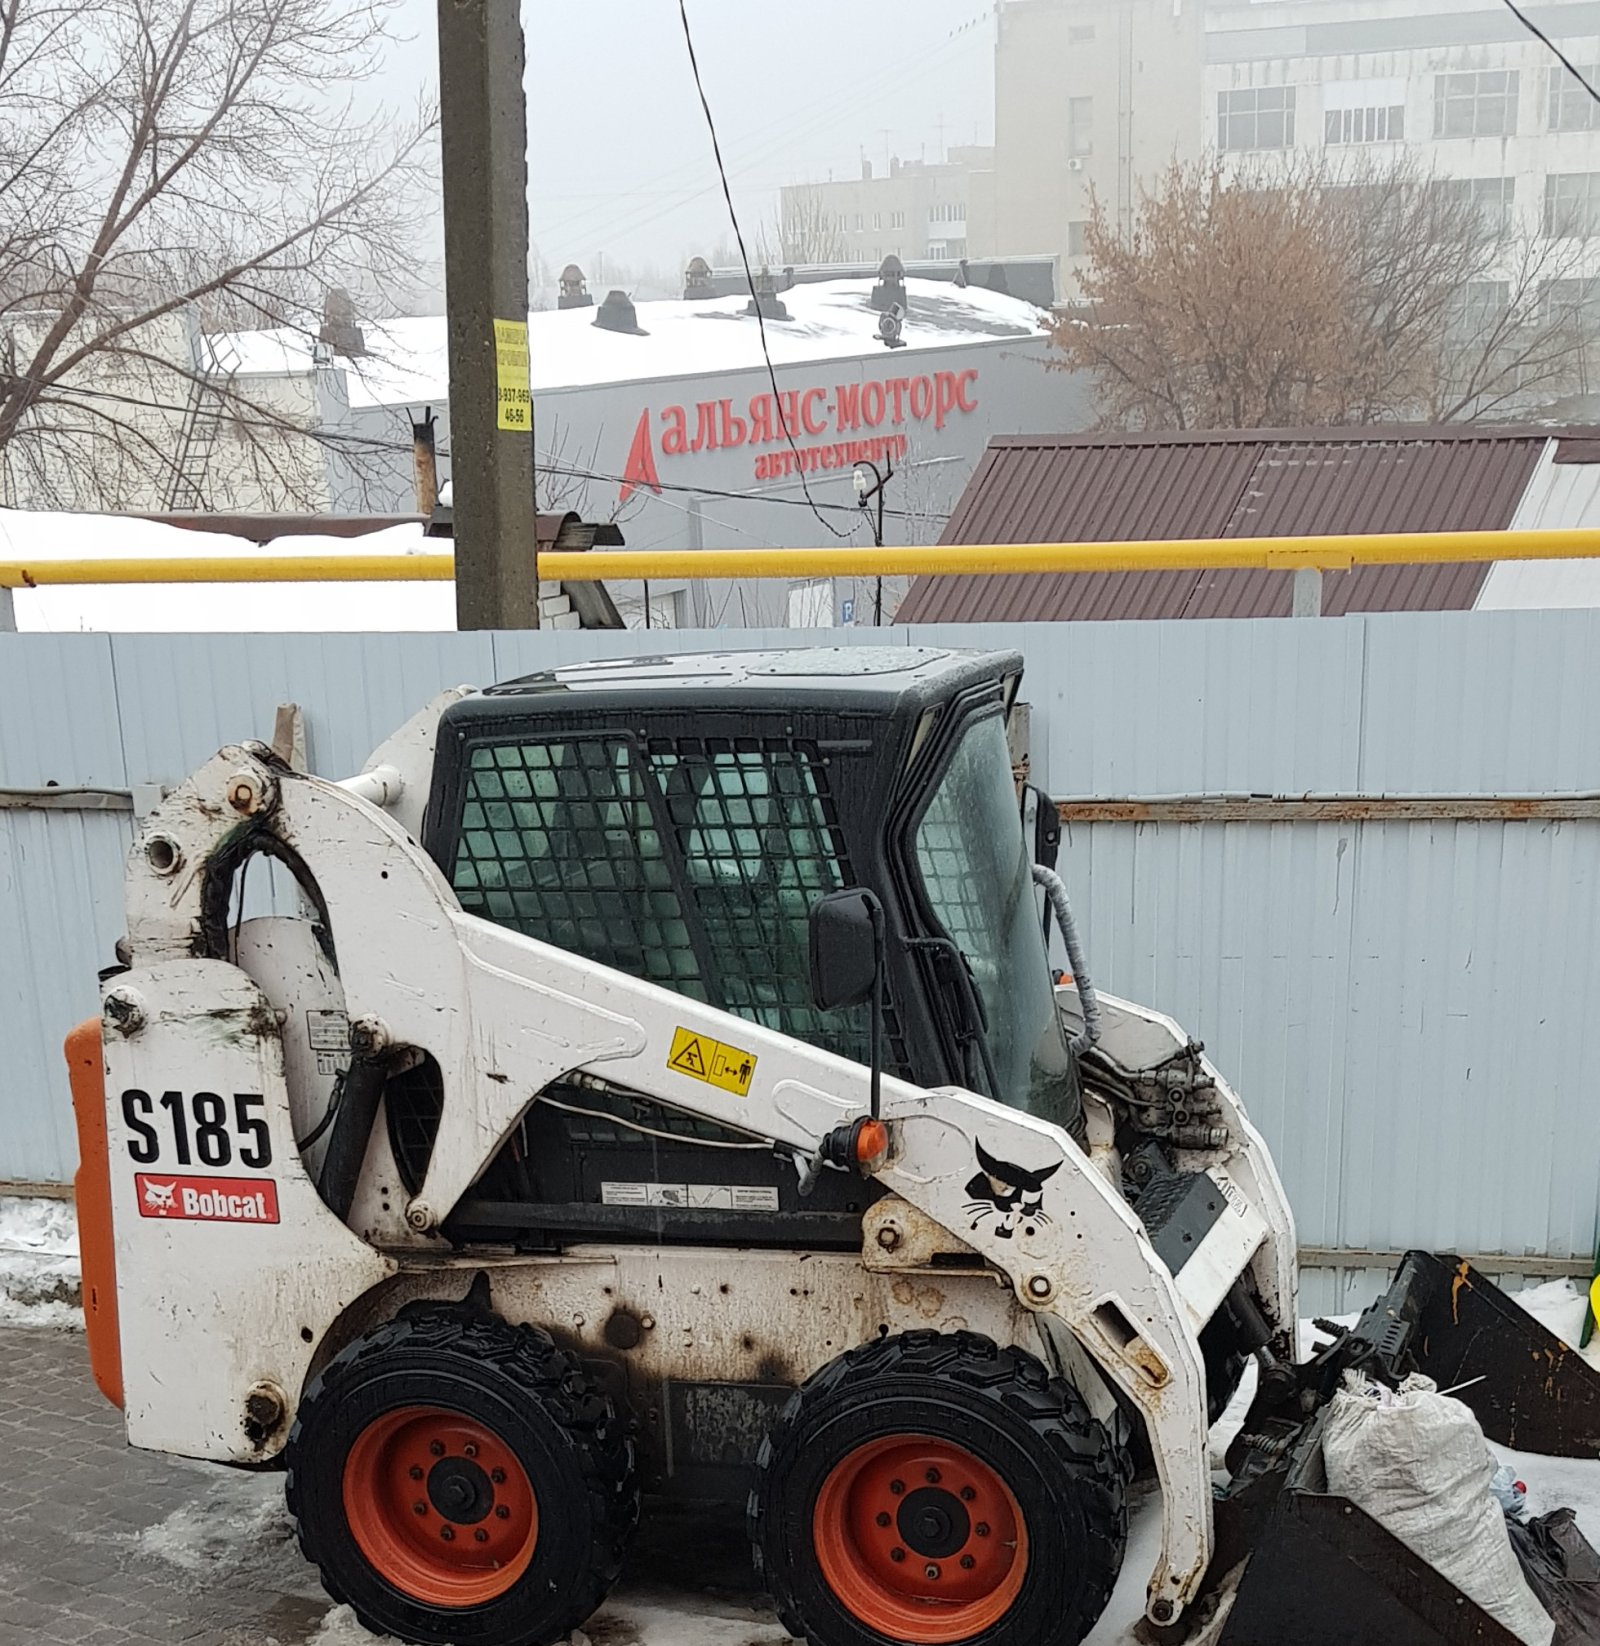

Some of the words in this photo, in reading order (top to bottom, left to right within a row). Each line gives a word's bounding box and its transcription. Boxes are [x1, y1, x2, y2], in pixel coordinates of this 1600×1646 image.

[754, 434, 908, 480] автотехцентр
[121, 1089, 272, 1169] S185
[181, 1187, 268, 1220] Bobcat
